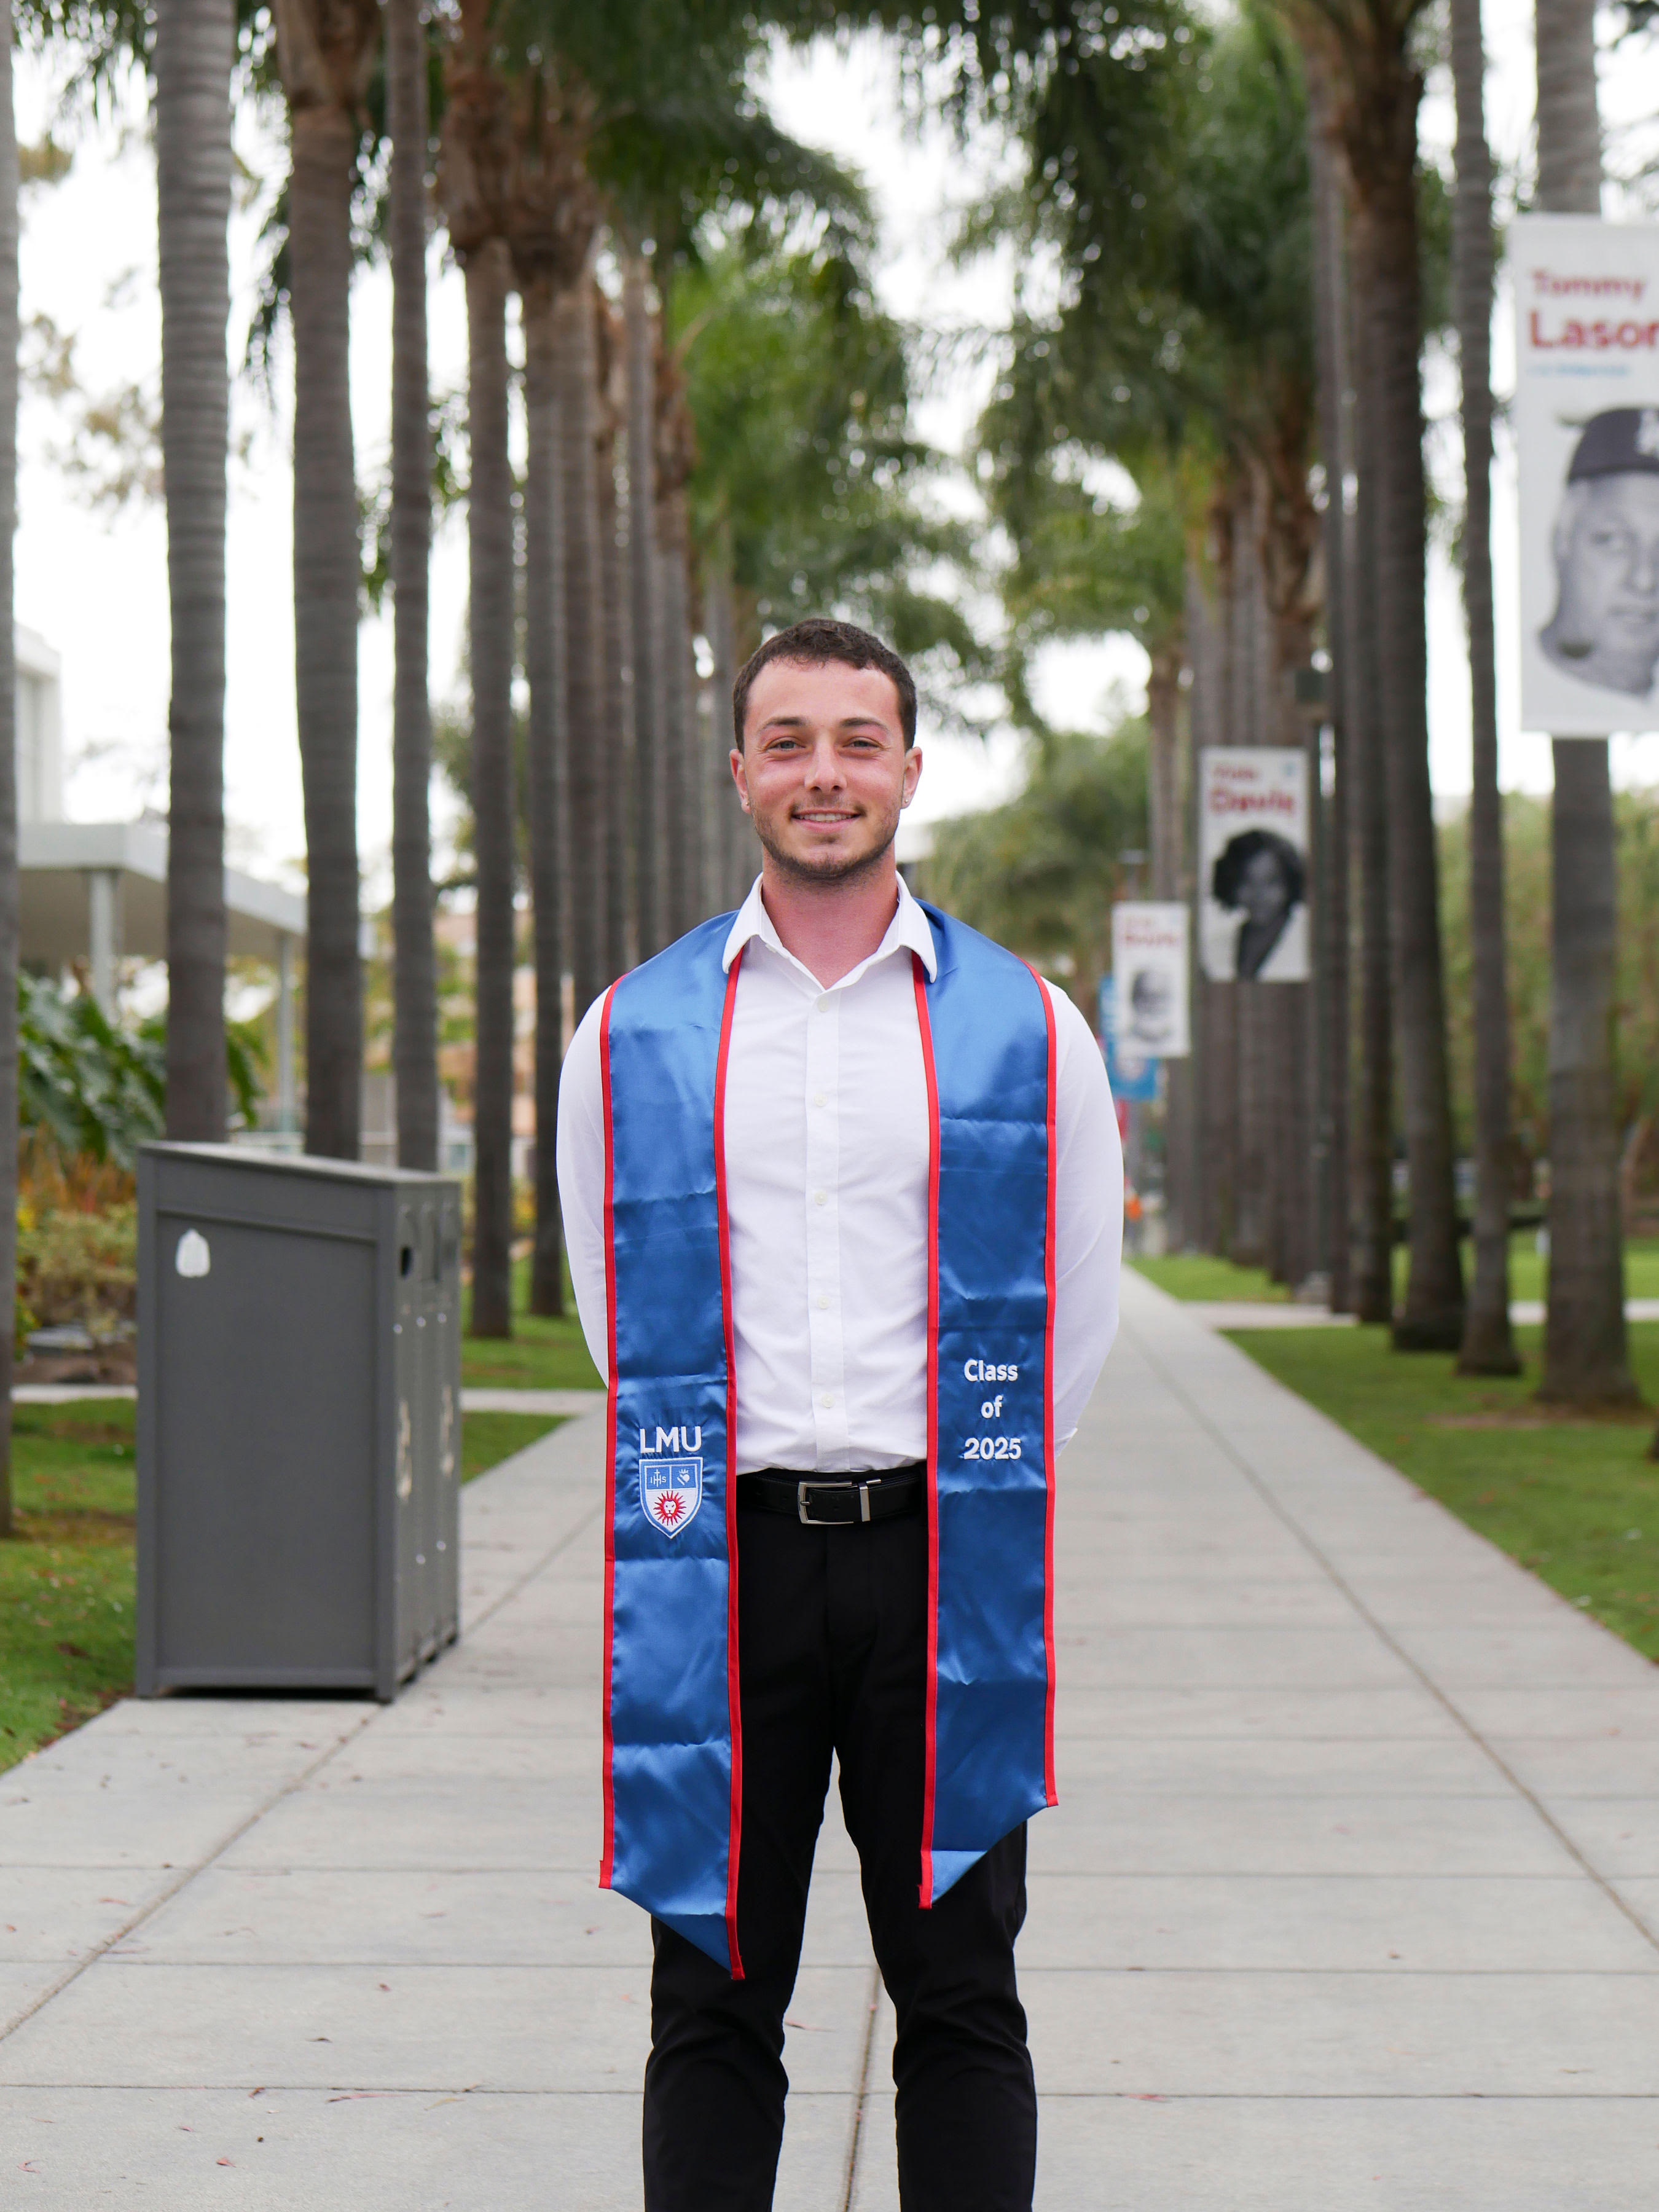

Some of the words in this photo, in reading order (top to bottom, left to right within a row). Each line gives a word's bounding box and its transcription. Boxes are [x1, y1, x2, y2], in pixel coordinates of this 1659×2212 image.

[1531, 269, 1647, 302] Tommy
[964, 1359, 1018, 1382] Class
[981, 1395, 1003, 1419] of
[640, 1426, 702, 1454] LMU
[963, 1437, 1022, 1460] 2025
